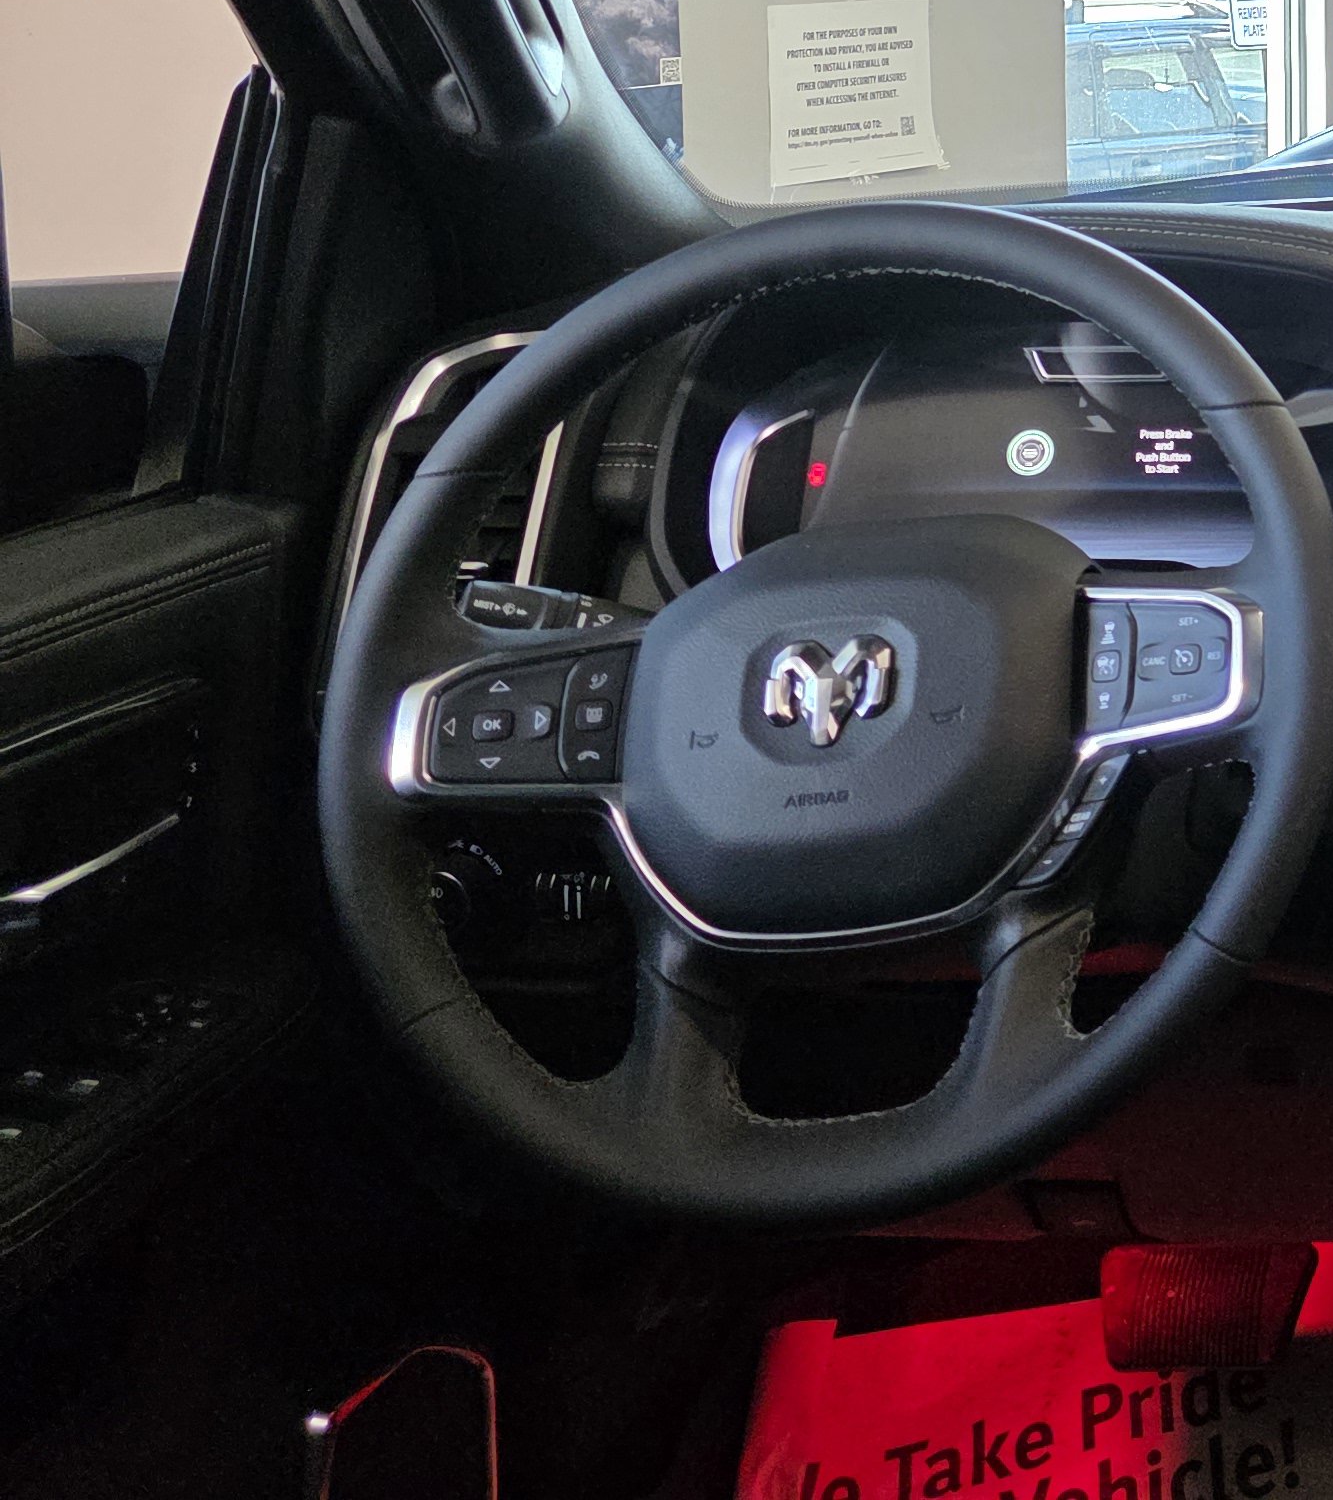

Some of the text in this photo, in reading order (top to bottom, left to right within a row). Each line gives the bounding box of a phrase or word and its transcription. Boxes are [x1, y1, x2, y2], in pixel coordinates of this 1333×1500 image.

[803, 26, 897, 41] FOR THE PURPOSES OF YOUR OWN
[1244, 24, 1266, 37] PLATE
[787, 40, 913, 59] PROTECTION AND PRIVACY, YOU ARE ADVISED
[814, 58, 889, 72] TO INSTALL A FIREWALL OR
[796, 72, 907, 91] OTHER COMPUTER SECURITY MEASURES
[806, 98, 824, 107] WHEN
[826, 94, 856, 105] ACCESSING
[858, 92, 868, 101] THE
[788, 119, 882, 138] FOR MORE INFORMATION, GO TO:
[1140, 429, 1193, 439] Press Brake
[1155, 441, 1174, 450] and
[1136, 452, 1191, 462] Push Button
[1145, 464, 1179, 473] to Start
[1178, 616, 1199, 627] SET+
[1142, 656, 1166, 667] CANC
[482, 718, 501, 732] OK
[784, 790, 849, 809] AIRBAG
[483, 854, 502, 876] AUTO
[884, 1418, 1054, 1500] Take
[1081, 1366, 1268, 1451] Pride
